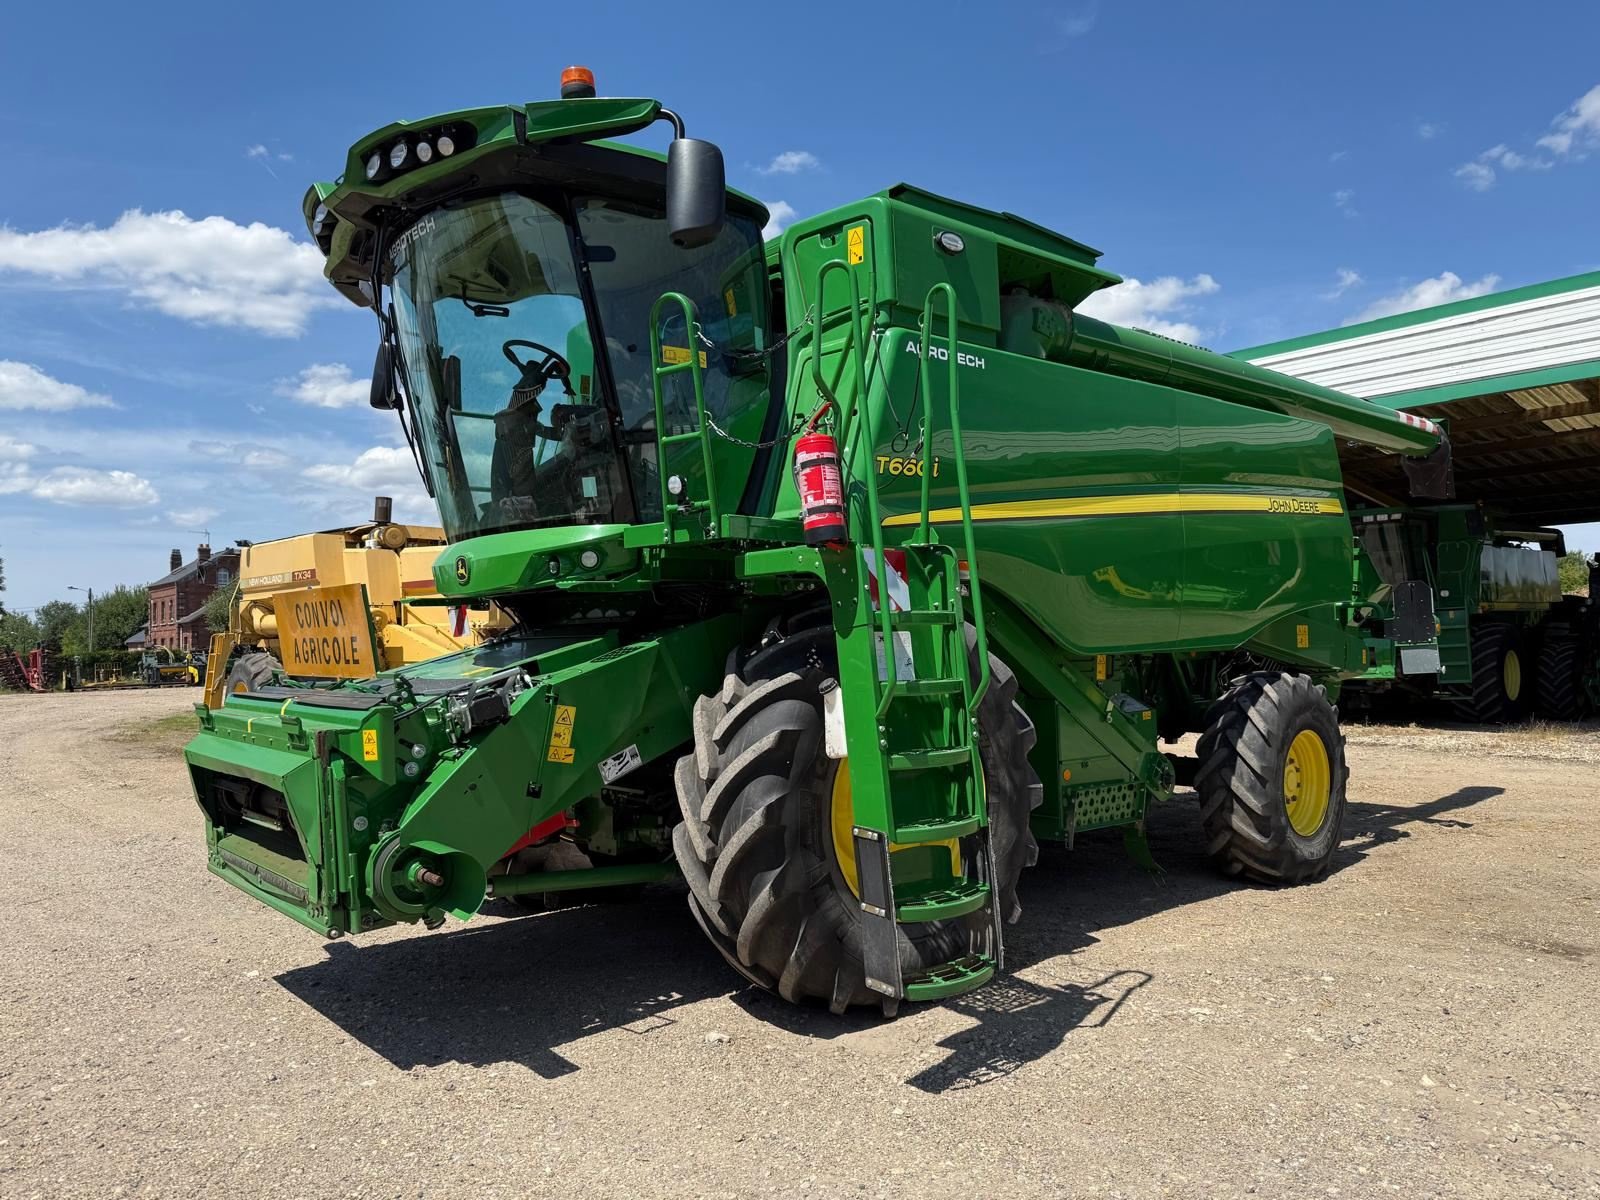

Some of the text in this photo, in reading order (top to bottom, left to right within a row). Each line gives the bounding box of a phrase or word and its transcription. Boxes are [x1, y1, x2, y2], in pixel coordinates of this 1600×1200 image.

[906, 341, 985, 370] AROECH
[1268, 497, 1320, 513] JOHN DEERE
[294, 570, 312, 581] TX34
[295, 599, 346, 629] CONVOI
[294, 636, 360, 665] AGRICOLE
